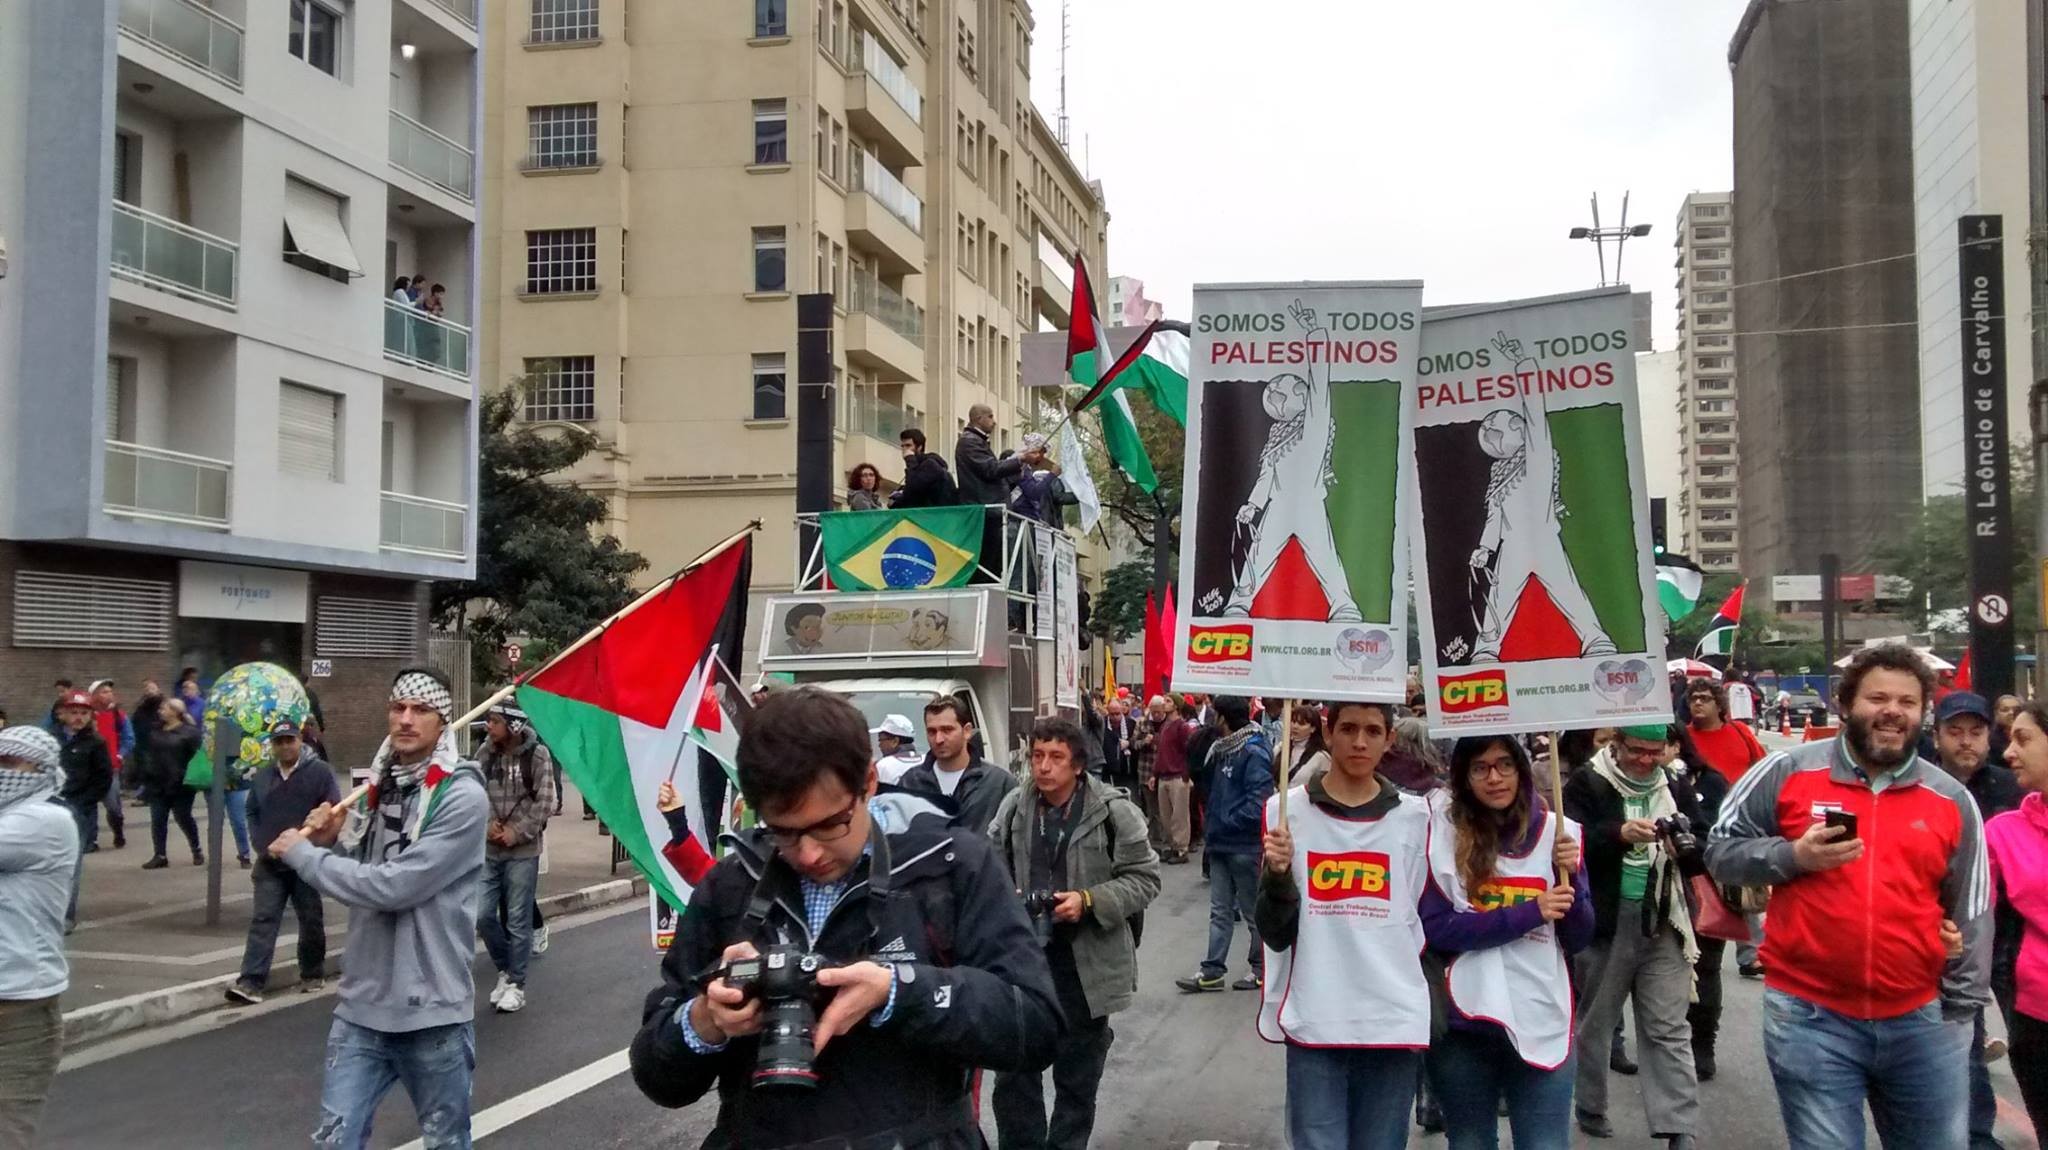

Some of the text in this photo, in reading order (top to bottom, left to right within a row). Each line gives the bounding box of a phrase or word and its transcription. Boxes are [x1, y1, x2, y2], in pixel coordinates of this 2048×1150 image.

[1197, 312, 1414, 332] SOMOS TODOS
[1211, 341, 1398, 364] PALESTINOS
[1417, 329, 1627, 376] OMOS TODOS
[1418, 362, 1614, 409] PALESTINOS
[1971, 276, 1997, 537] R. Leôncio de Carvalho
[1191, 631, 1250, 656] CTB
[1260, 645, 1332, 656] WWW.CTB.ORG.BR
[313, 662, 330, 675] 266
[1607, 672, 1638, 686] FSM
[1443, 678, 1503, 705] CTB
[1515, 683, 1590, 696] WWW.CTB.ORG.BR
[1312, 859, 1385, 892] CTB
